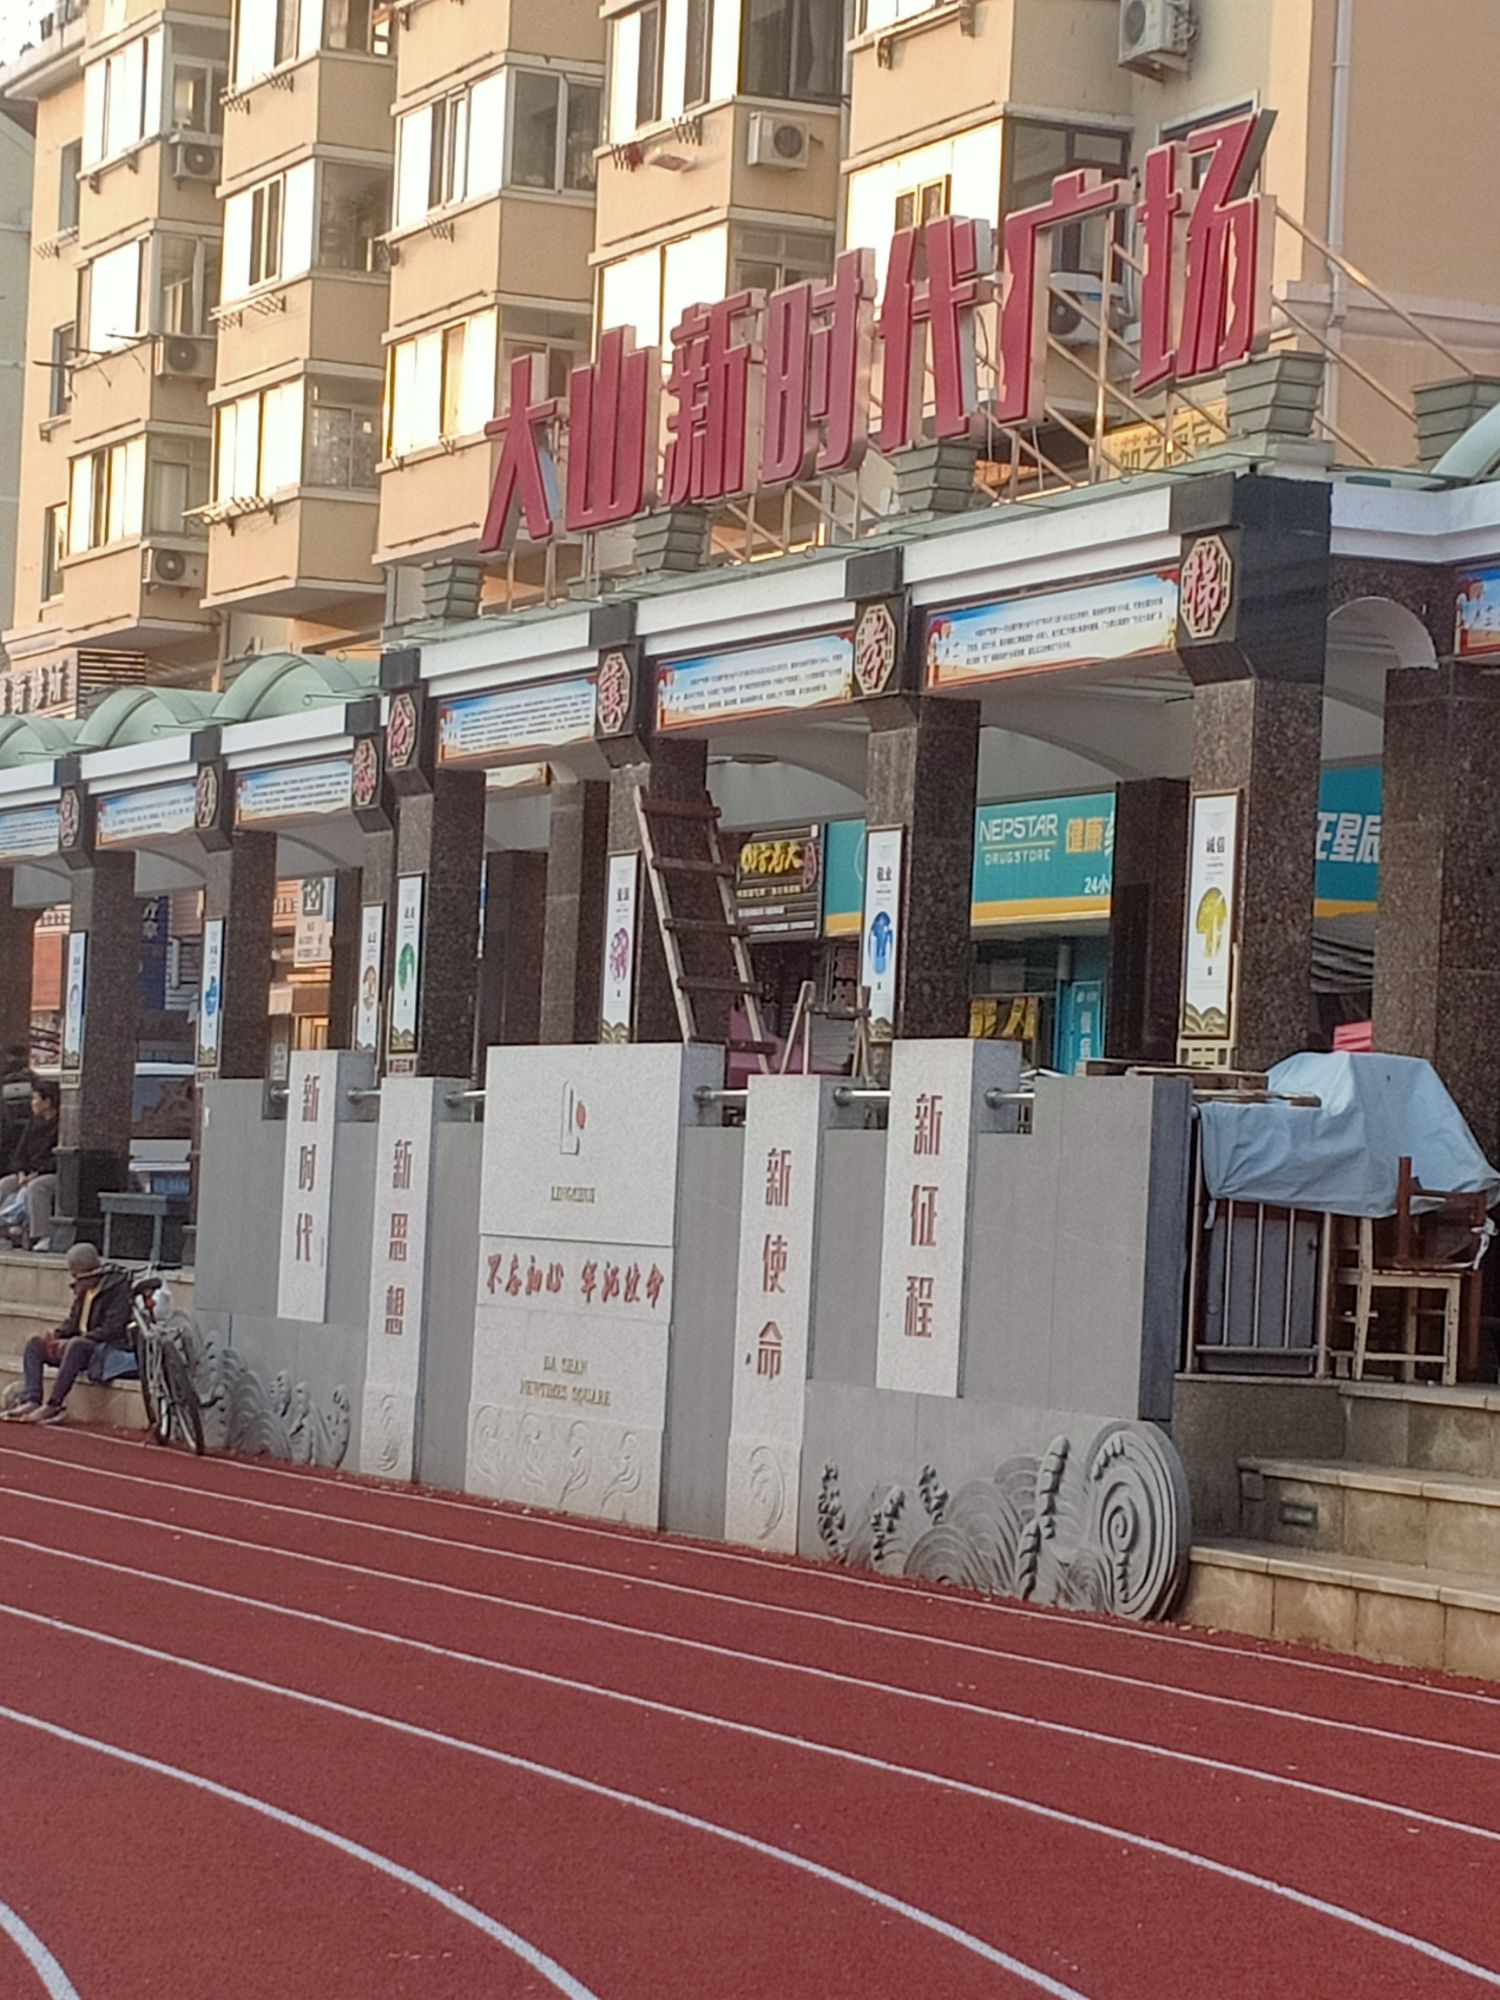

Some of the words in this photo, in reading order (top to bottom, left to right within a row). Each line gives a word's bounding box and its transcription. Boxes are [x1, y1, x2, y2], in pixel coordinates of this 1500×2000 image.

[480, 110, 1270, 552] 大山新时代广场
[979, 814, 1058, 842] NEPSTAR
[985, 849, 1051, 866] DRUGSTORE
[296, 1074, 320, 1262] 新时代
[385, 1139, 412, 1336] 新思想
[757, 1147, 792, 1380] 新使命
[904, 1093, 943, 1338] 新征程
[487, 1254, 564, 1296] 不忘初心
